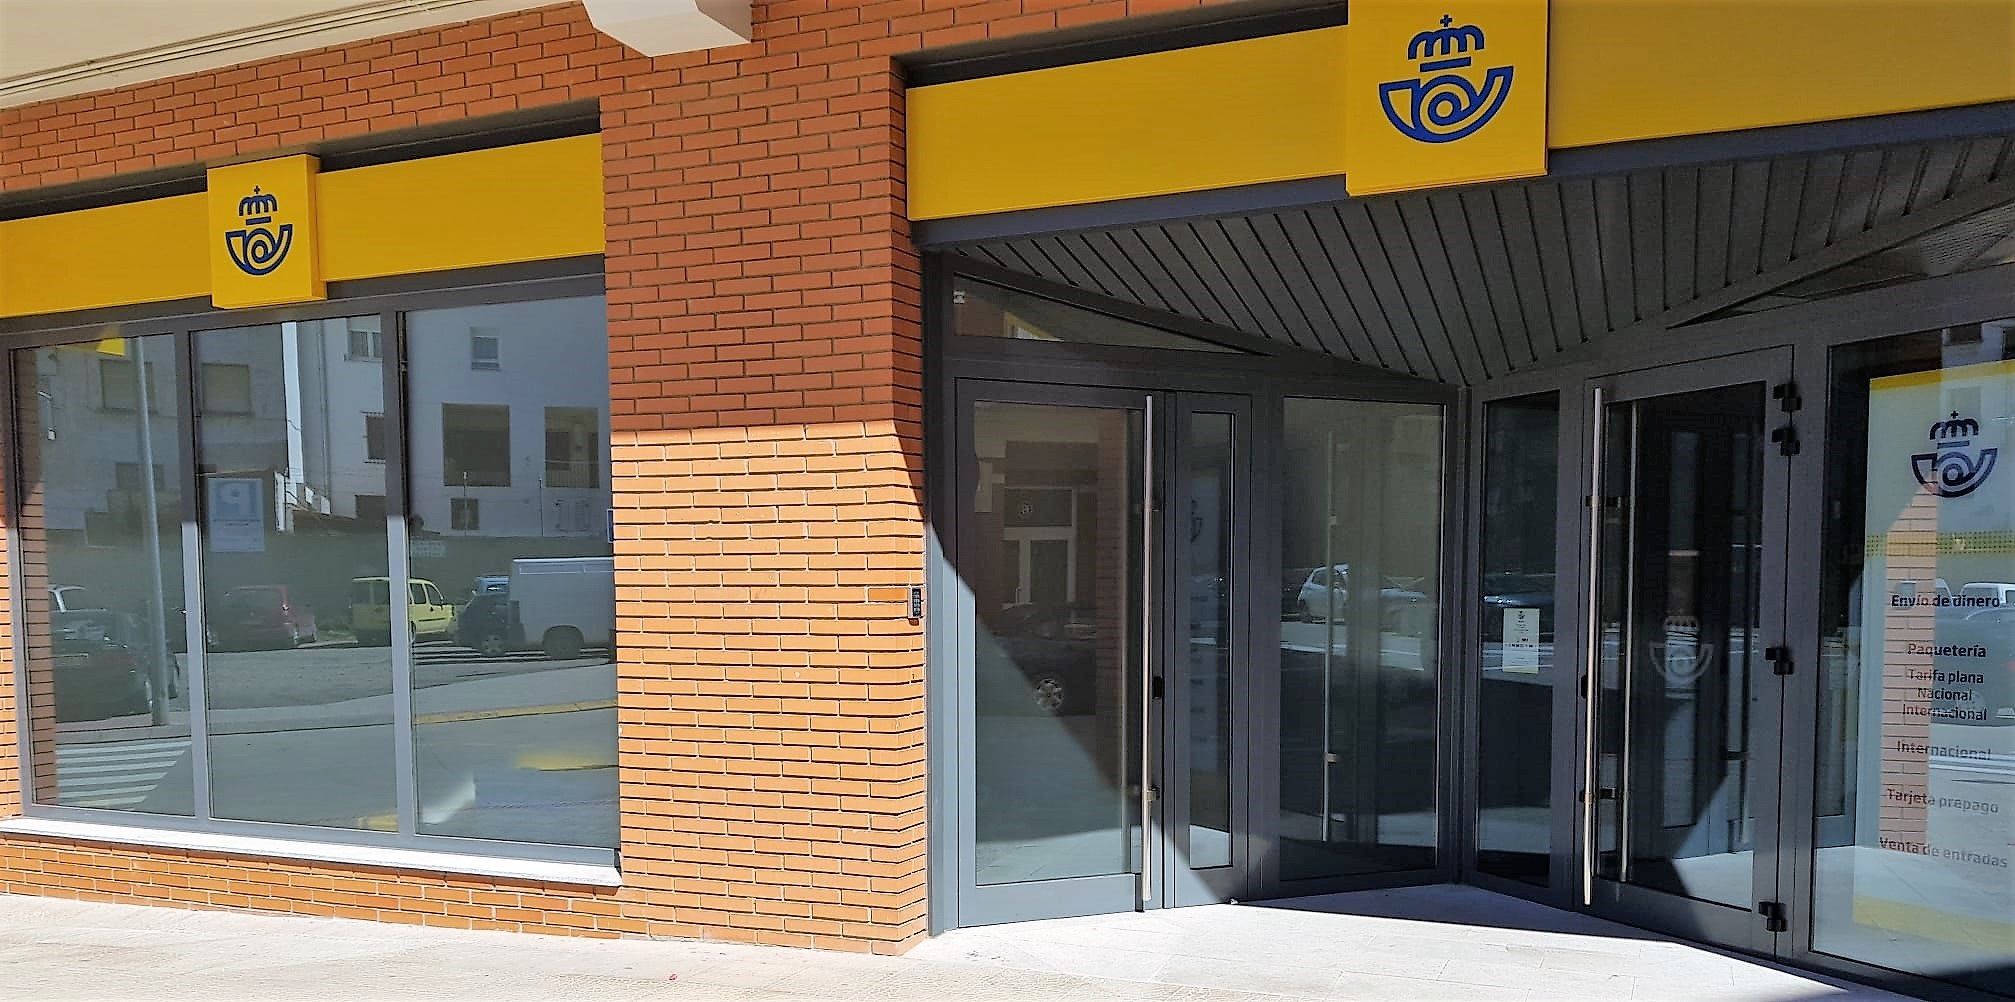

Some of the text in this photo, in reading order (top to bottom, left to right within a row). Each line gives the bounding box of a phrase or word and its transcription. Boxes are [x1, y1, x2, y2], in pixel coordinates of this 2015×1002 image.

[1932, 594, 1951, 607] de
[1953, 595, 2000, 608] dinero
[1908, 643, 1986, 658] Paquetería
[1908, 668, 1985, 684] Tarifa plana
[1917, 687, 1972, 701] Nacional
[1902, 703, 1988, 721] Internacional
[1897, 741, 1992, 761] Internacional
[1887, 788, 1999, 815] Tarjeta prepago
[1879, 836, 2009, 868] Venta de entradas
